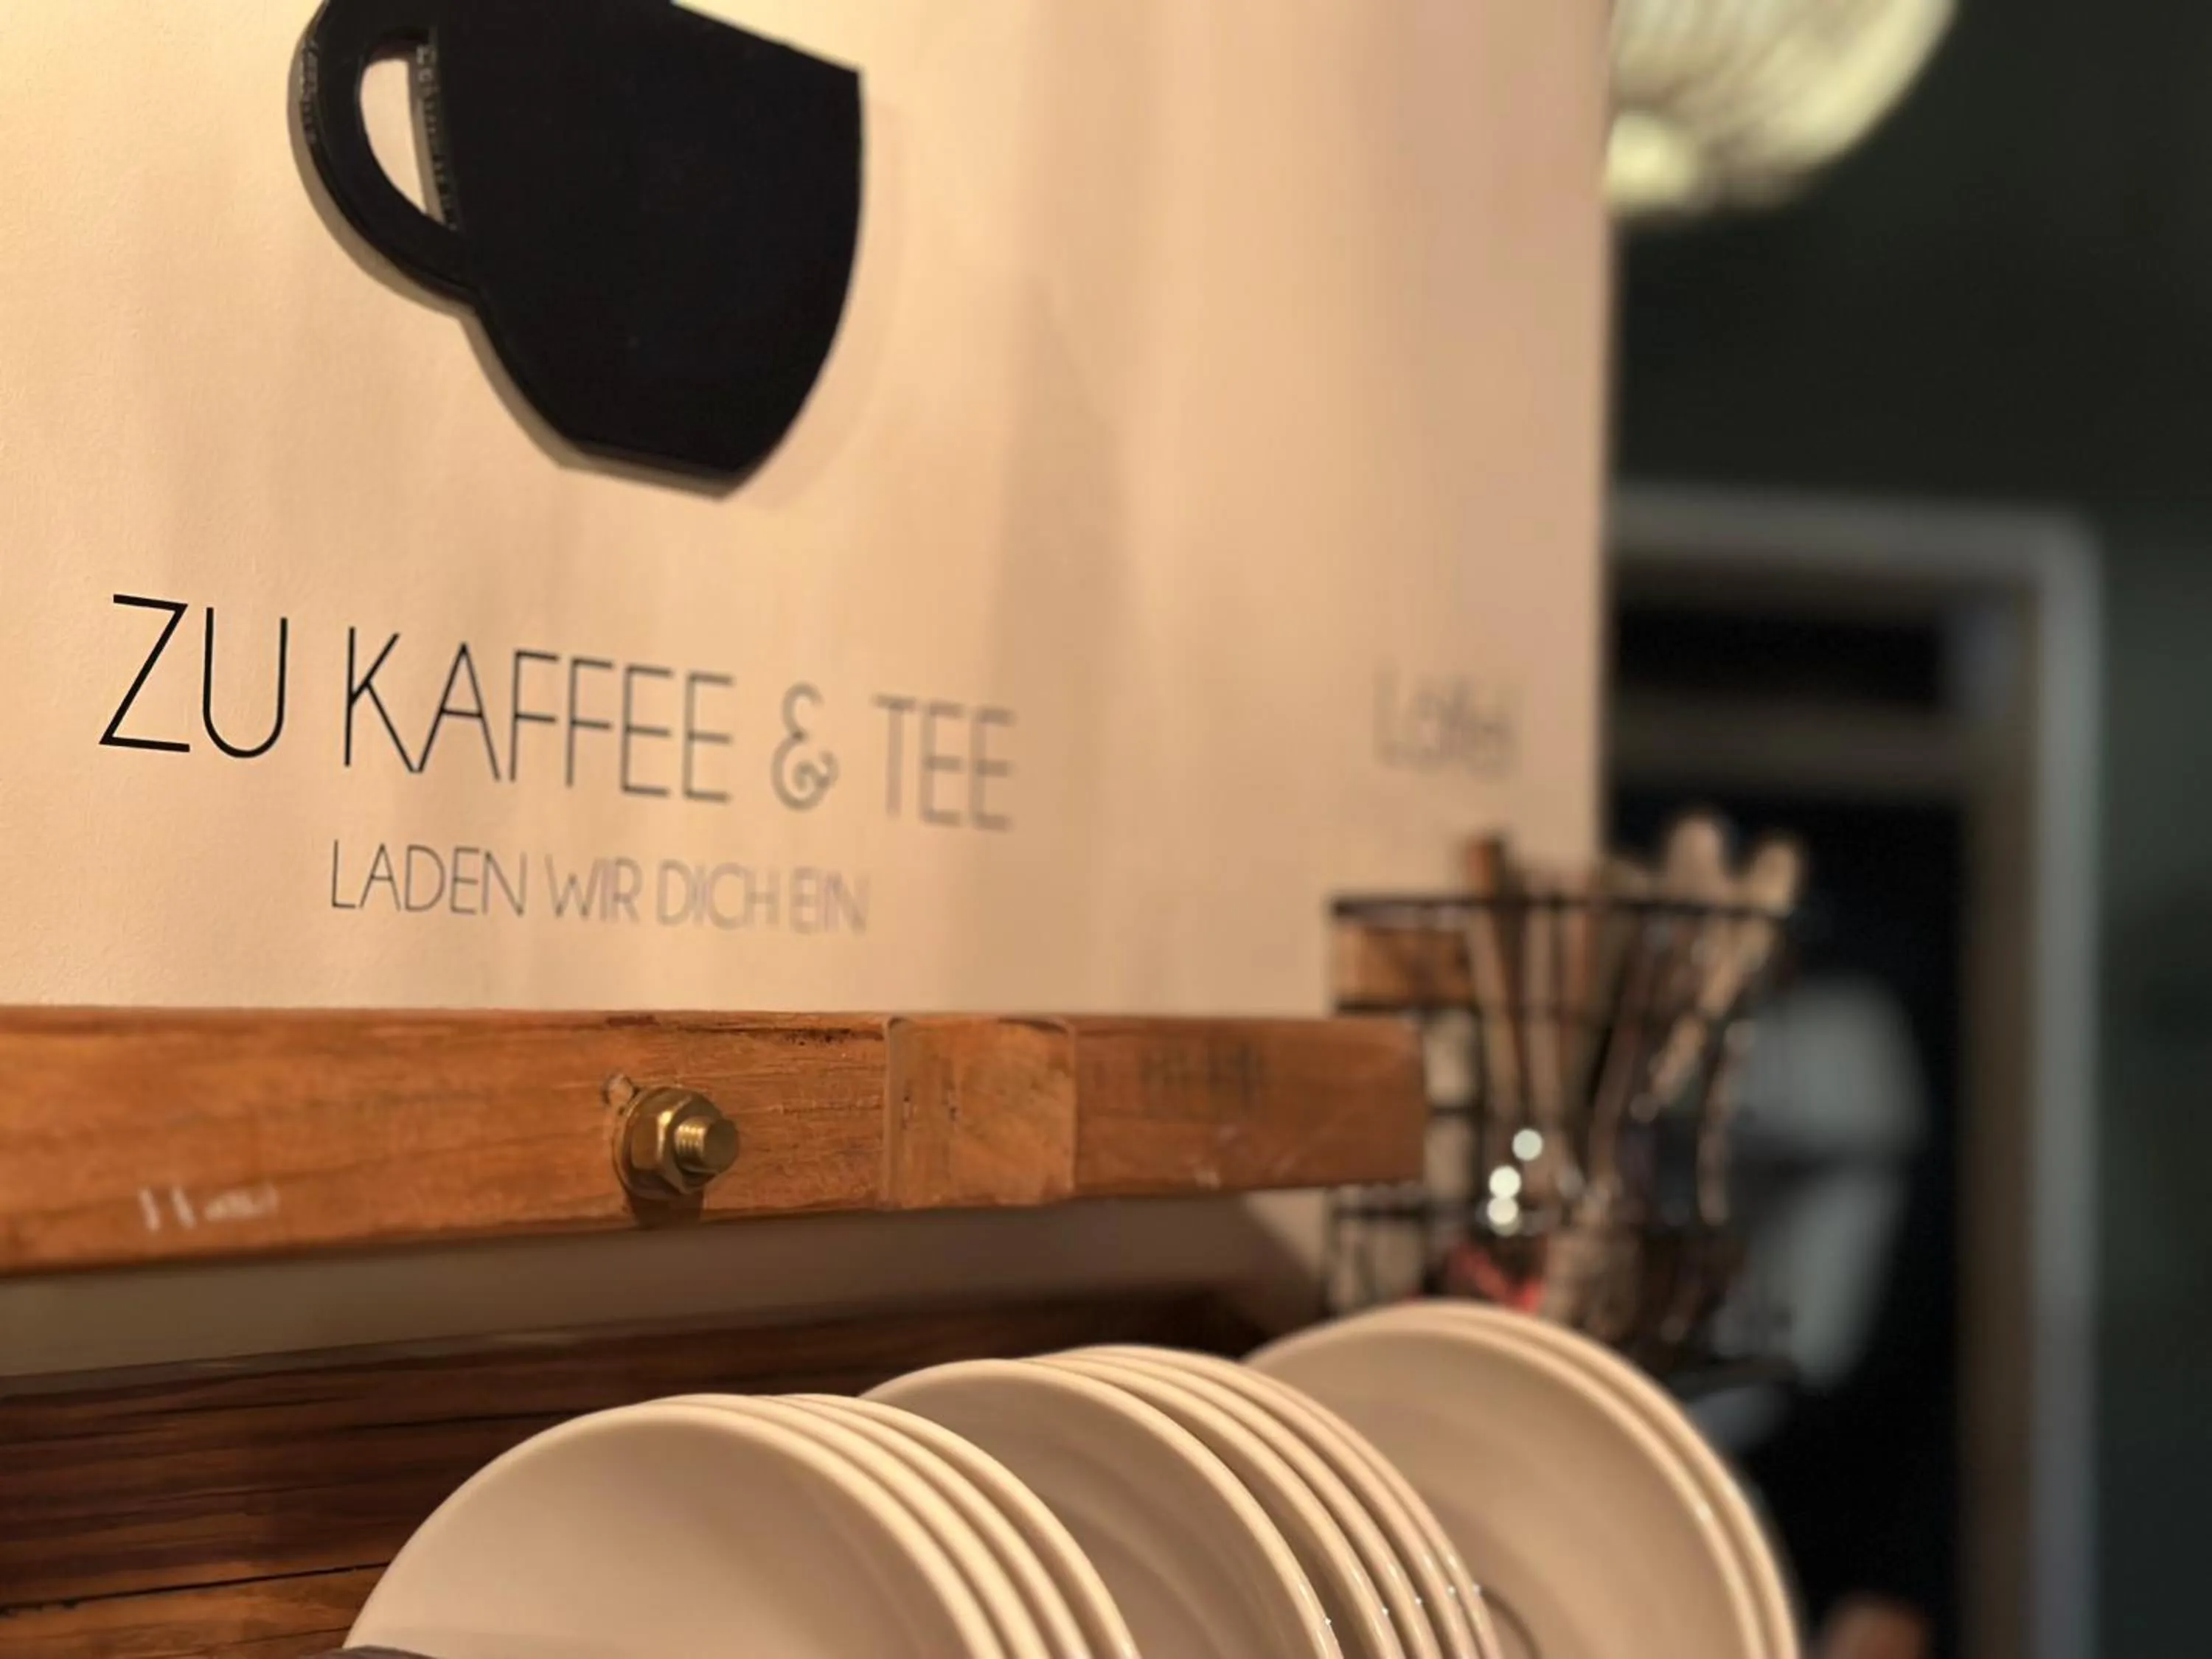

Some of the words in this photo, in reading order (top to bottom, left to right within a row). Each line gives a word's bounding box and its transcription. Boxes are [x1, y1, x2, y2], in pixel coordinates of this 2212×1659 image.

[98, 594, 288, 759] ZU
[344, 626, 733, 804] KAFFEE
[770, 683, 840, 811] &
[873, 693, 1017, 832] TEE
[331, 839, 527, 917] LADEN
[545, 853, 641, 924] WIR
[655, 858, 781, 931] DICH
[789, 865, 871, 936] EIN
